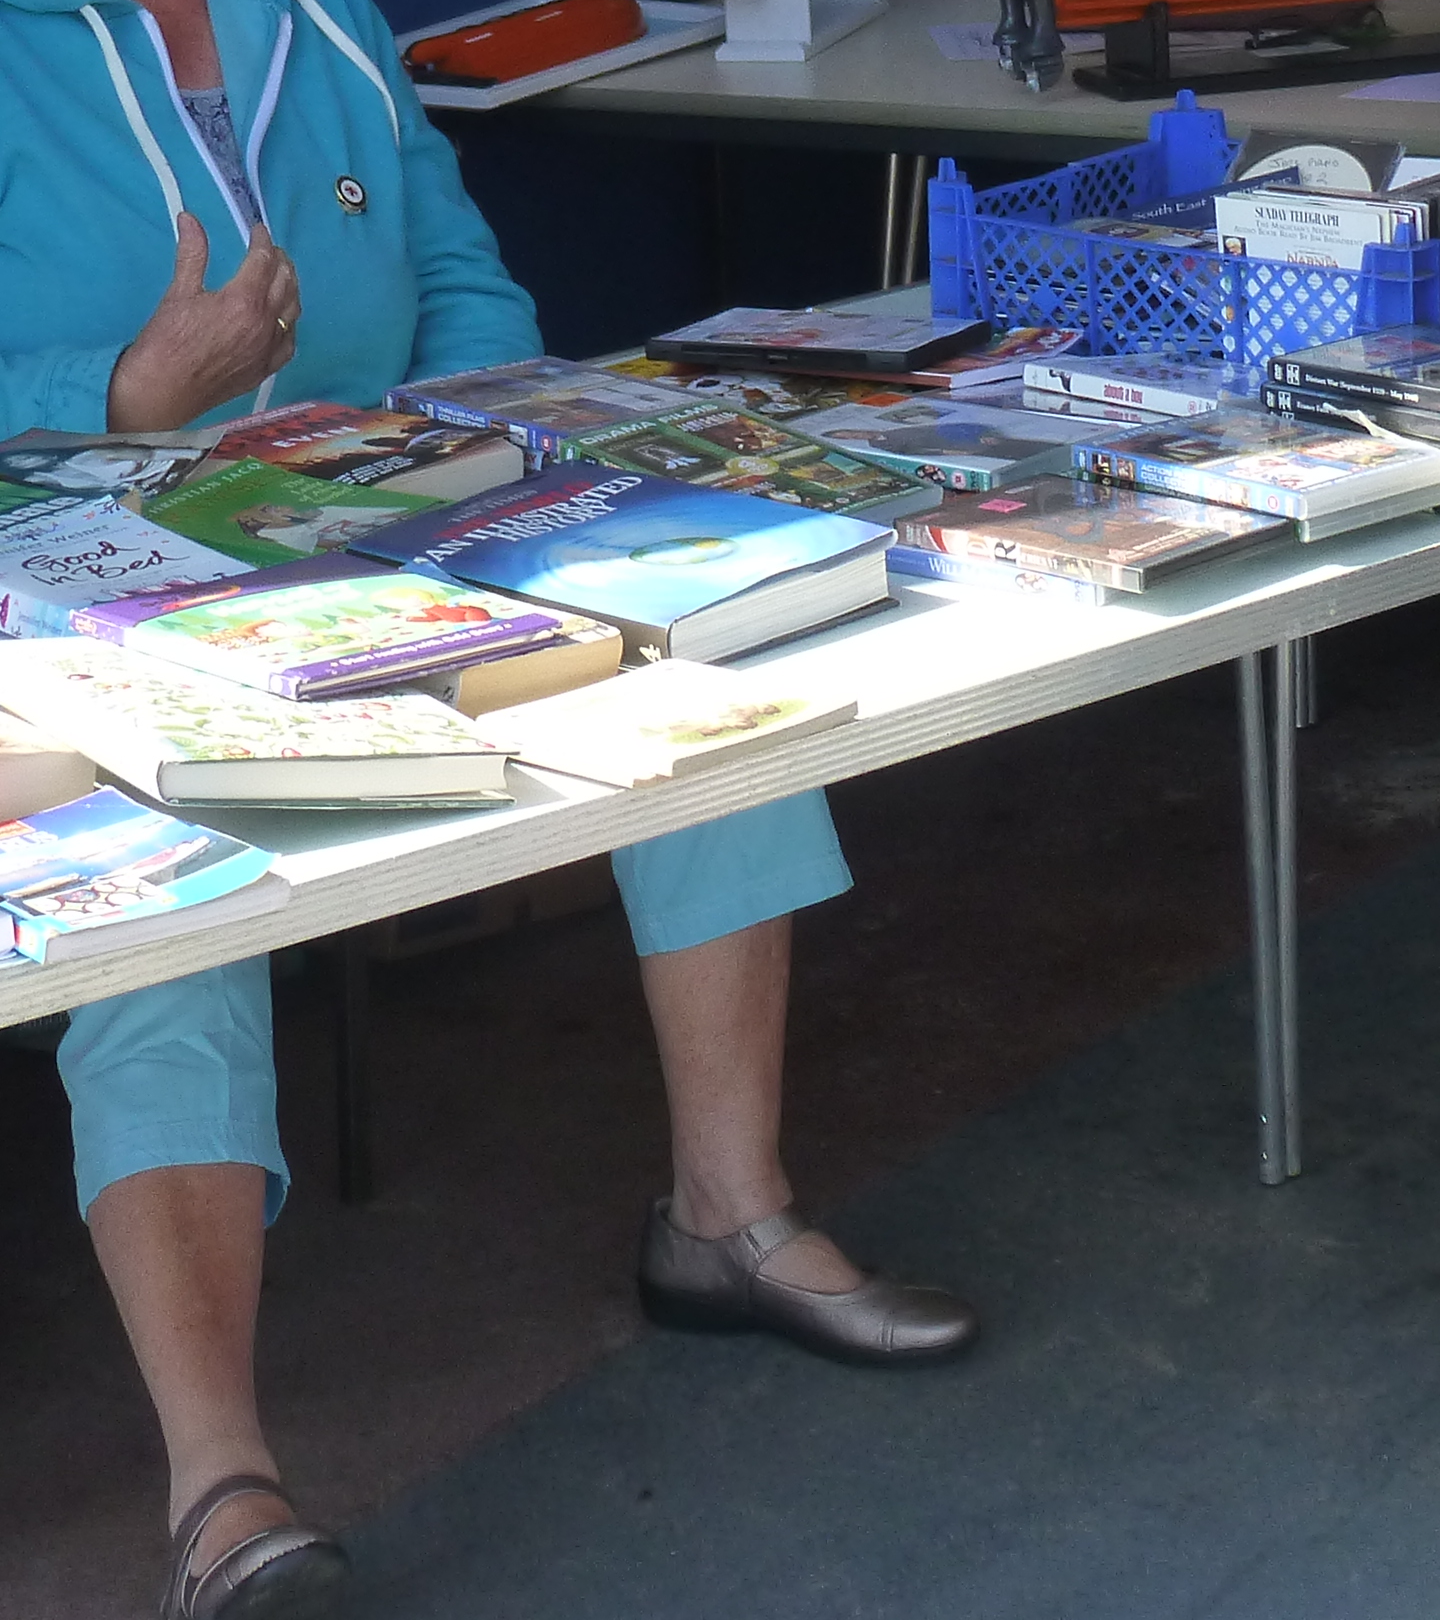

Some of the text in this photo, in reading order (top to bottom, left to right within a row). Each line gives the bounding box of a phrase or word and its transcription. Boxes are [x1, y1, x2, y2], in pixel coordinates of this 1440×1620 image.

[1132, 198, 1208, 221] South East
[1254, 207, 1340, 227] SUNDAY TELEGRAPH
[271, 426, 360, 448] EVEN
[579, 420, 657, 446] DRAMA
[658, 403, 718, 424] FILMS
[147, 478, 222, 516] HRISTIAN
[426, 539, 473, 563] AN
[464, 476, 643, 541] ILLUSTRATED
[493, 504, 618, 543] HISTORY
[21, 541, 140, 572] Good
[71, 549, 190, 579] Bed
